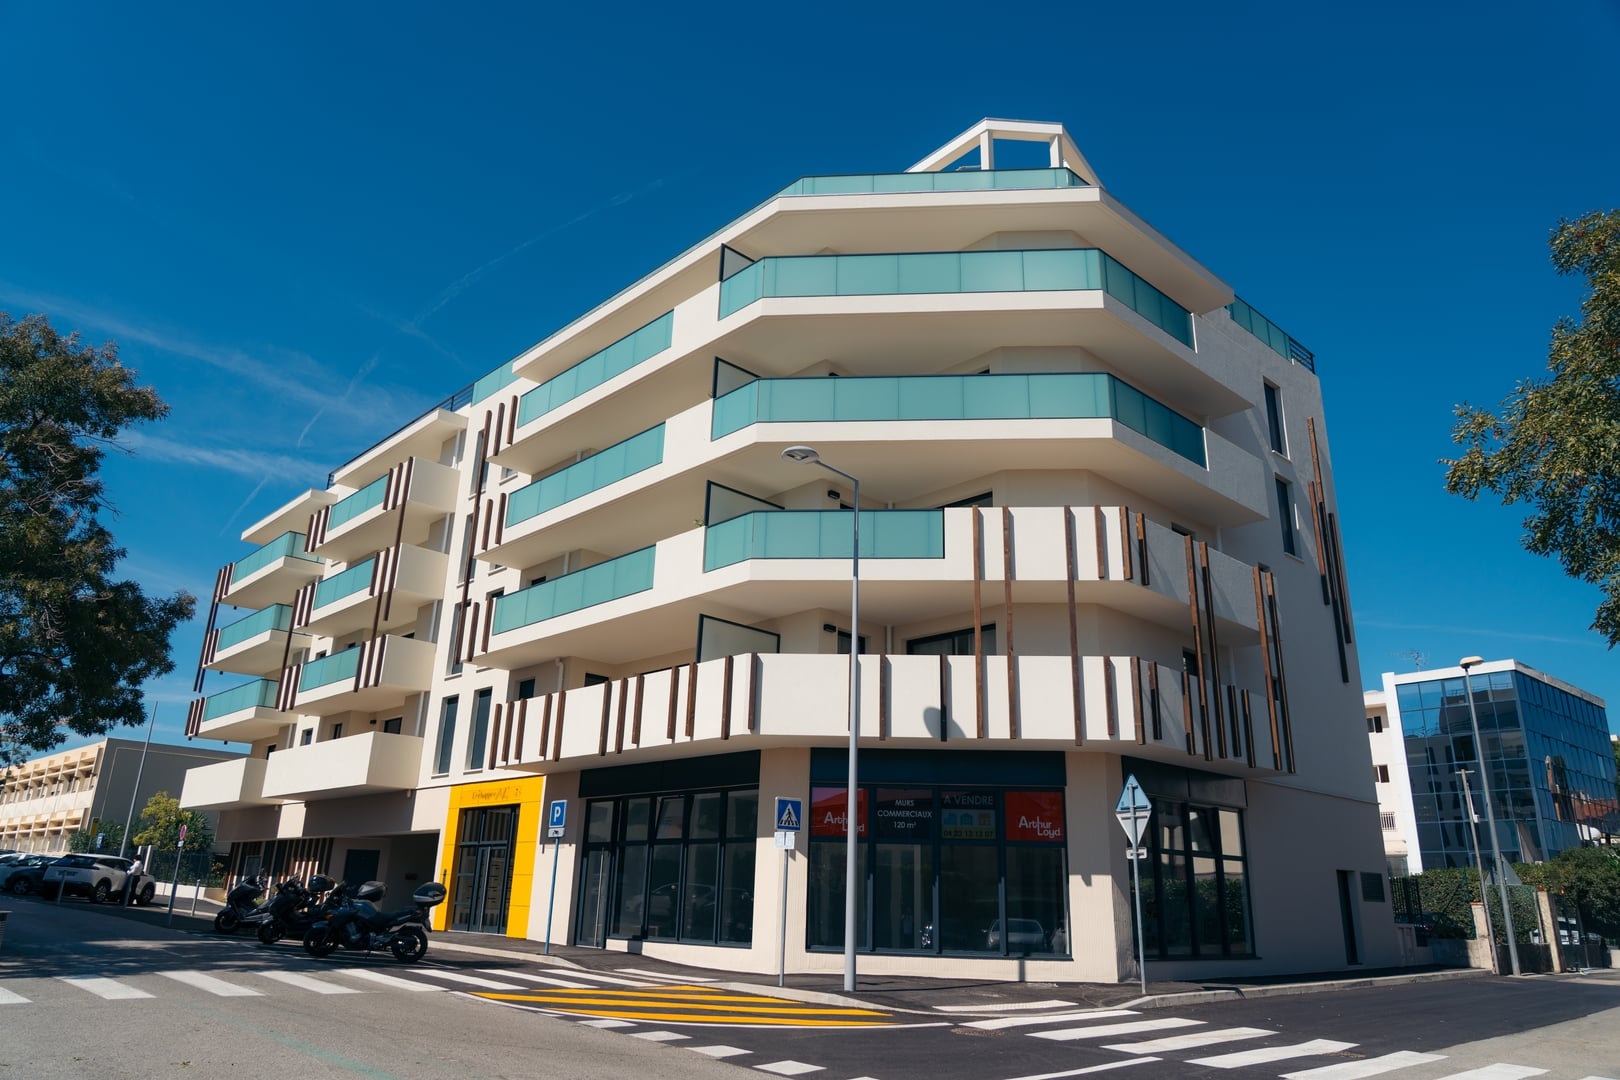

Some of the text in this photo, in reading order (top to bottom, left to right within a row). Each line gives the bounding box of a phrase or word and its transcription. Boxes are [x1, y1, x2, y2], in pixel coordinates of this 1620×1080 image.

[954, 795, 993, 805] VENDRE
[553, 806, 561, 822] P
[823, 811, 848, 824] Arth
[877, 809, 932, 817] COMMERCIAUX
[894, 821, 906, 829] 120
[1018, 816, 1052, 828] Arthur
[1037, 826, 1061, 838] Loyd
